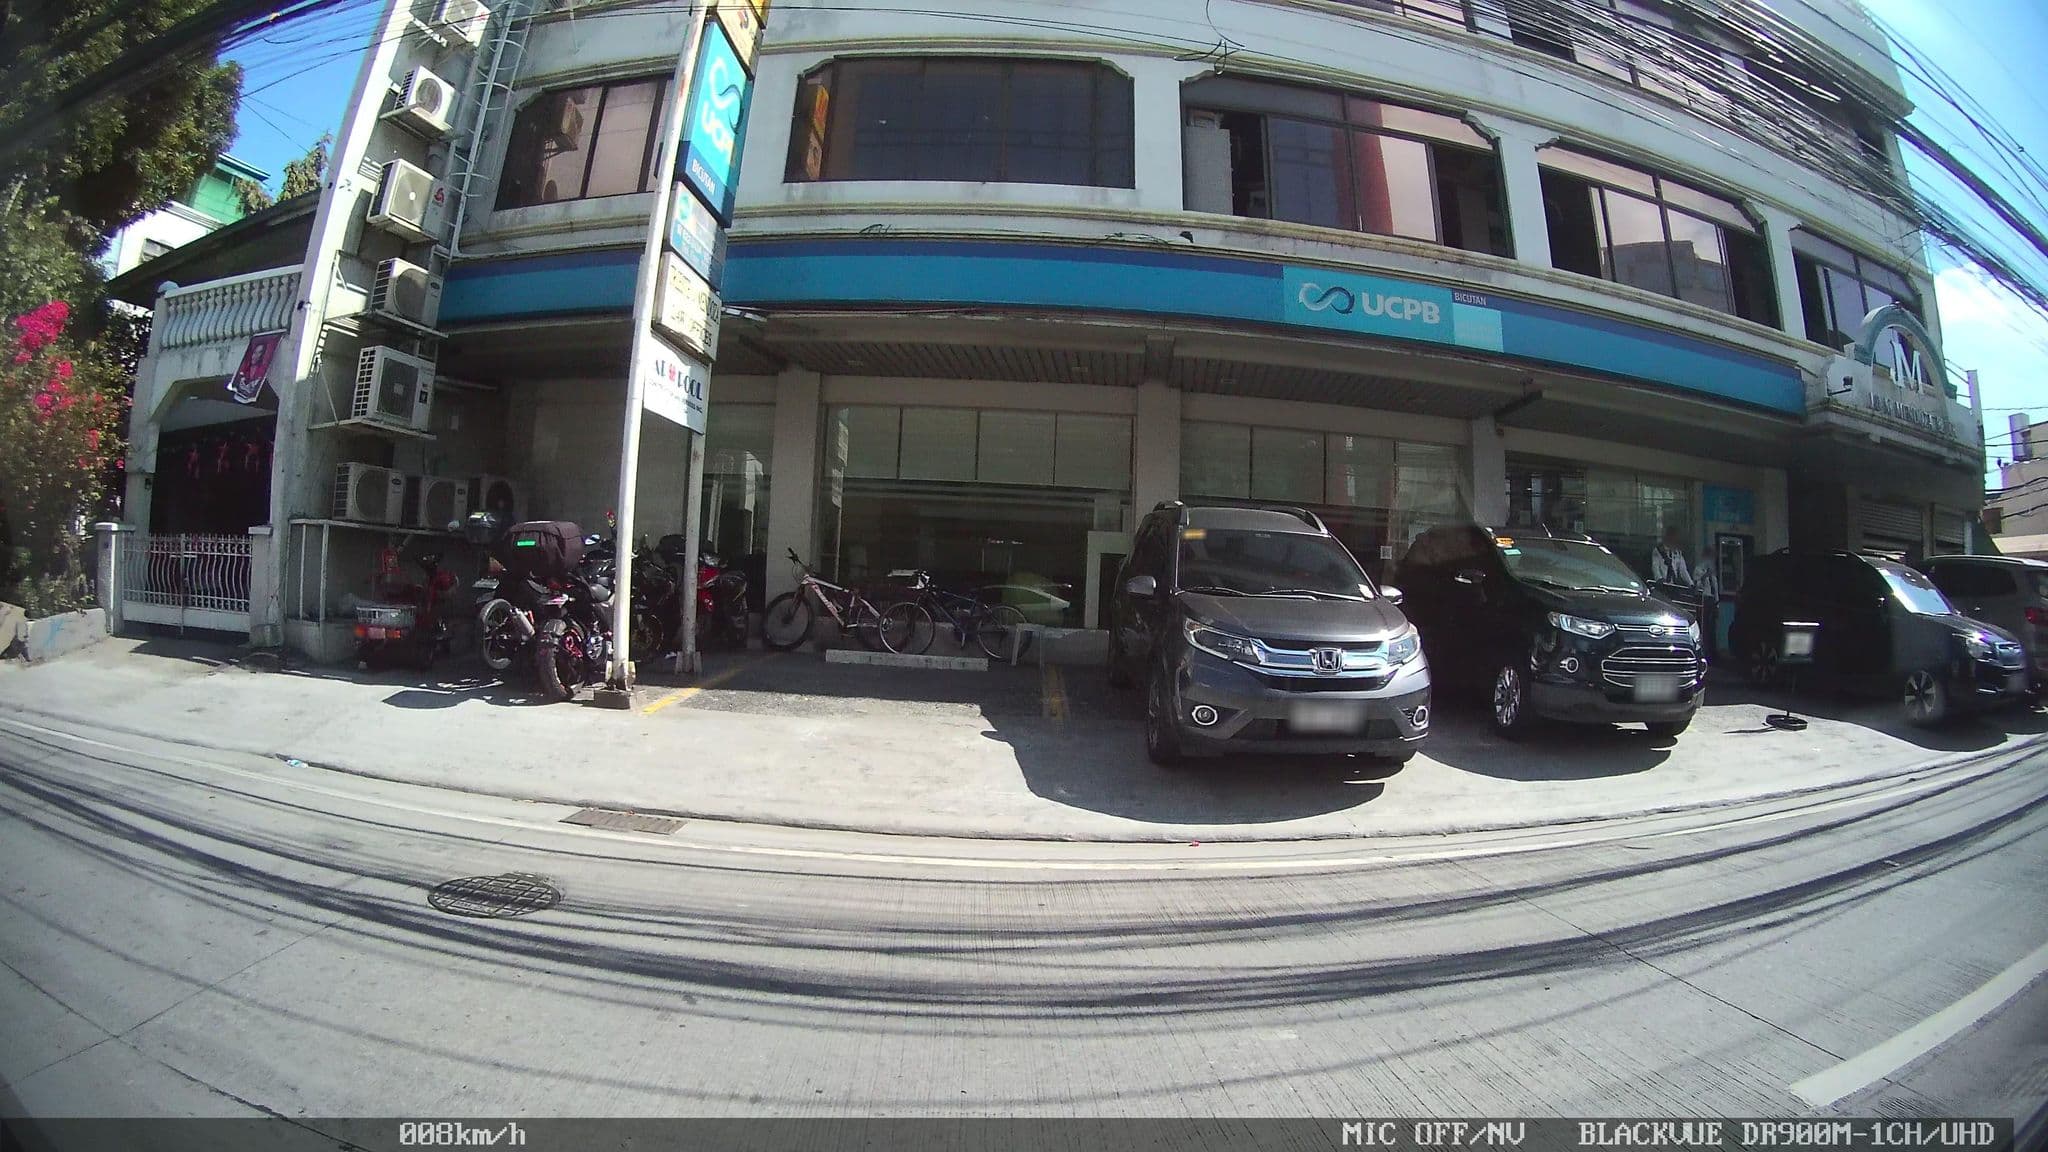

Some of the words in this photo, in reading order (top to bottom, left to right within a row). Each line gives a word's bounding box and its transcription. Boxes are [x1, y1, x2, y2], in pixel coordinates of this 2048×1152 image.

[692, 159, 716, 194] BICUTAN
[1361, 292, 1440, 324] UCPB
[1454, 292, 1488, 306] BICUTAN
